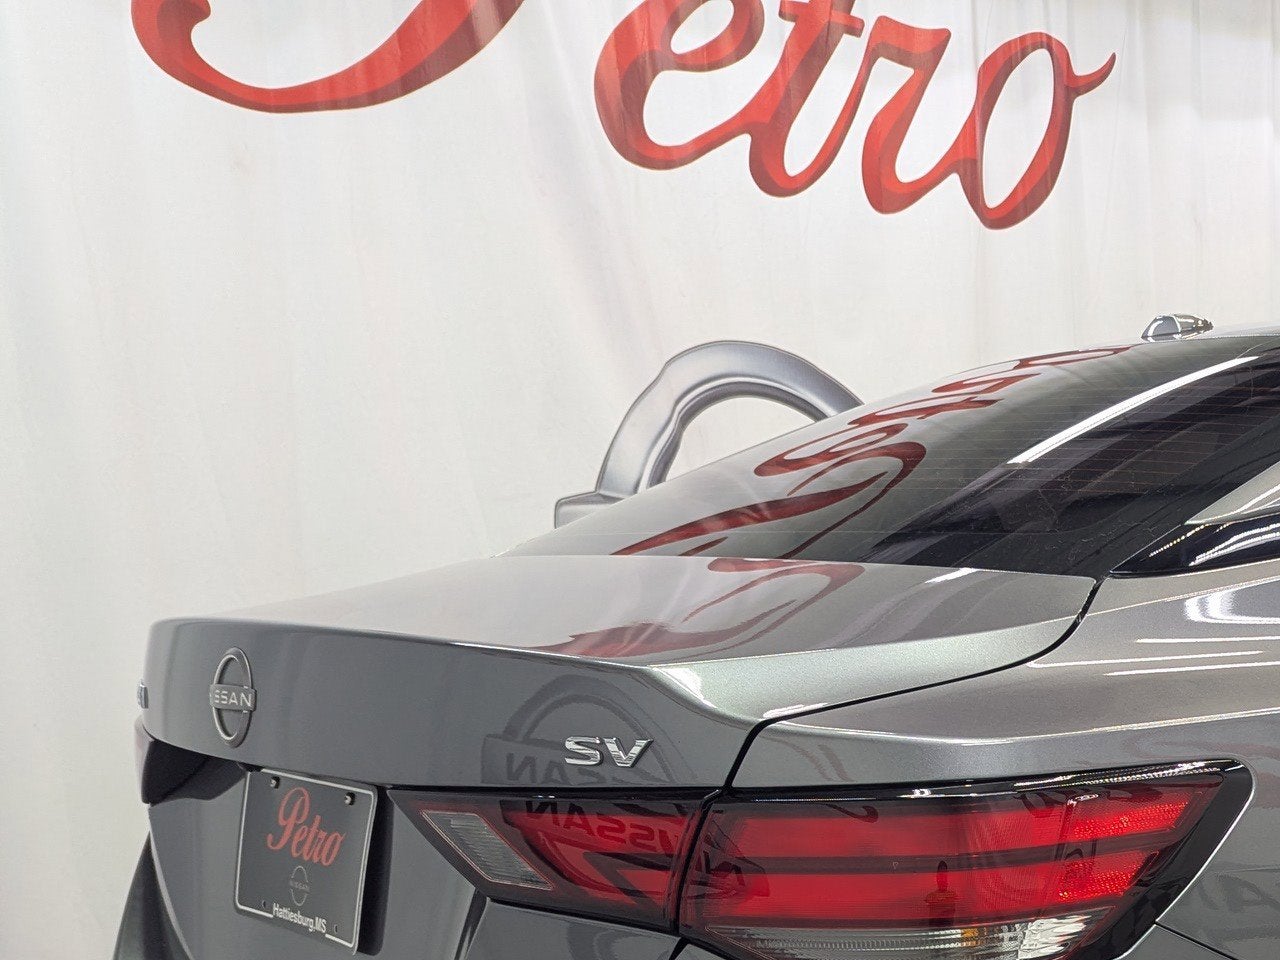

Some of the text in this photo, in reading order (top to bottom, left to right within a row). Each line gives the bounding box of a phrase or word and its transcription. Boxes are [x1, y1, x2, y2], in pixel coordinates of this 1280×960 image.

[210, 689, 252, 708] SSAN
[564, 736, 654, 768] SV
[266, 786, 347, 866] Petro
